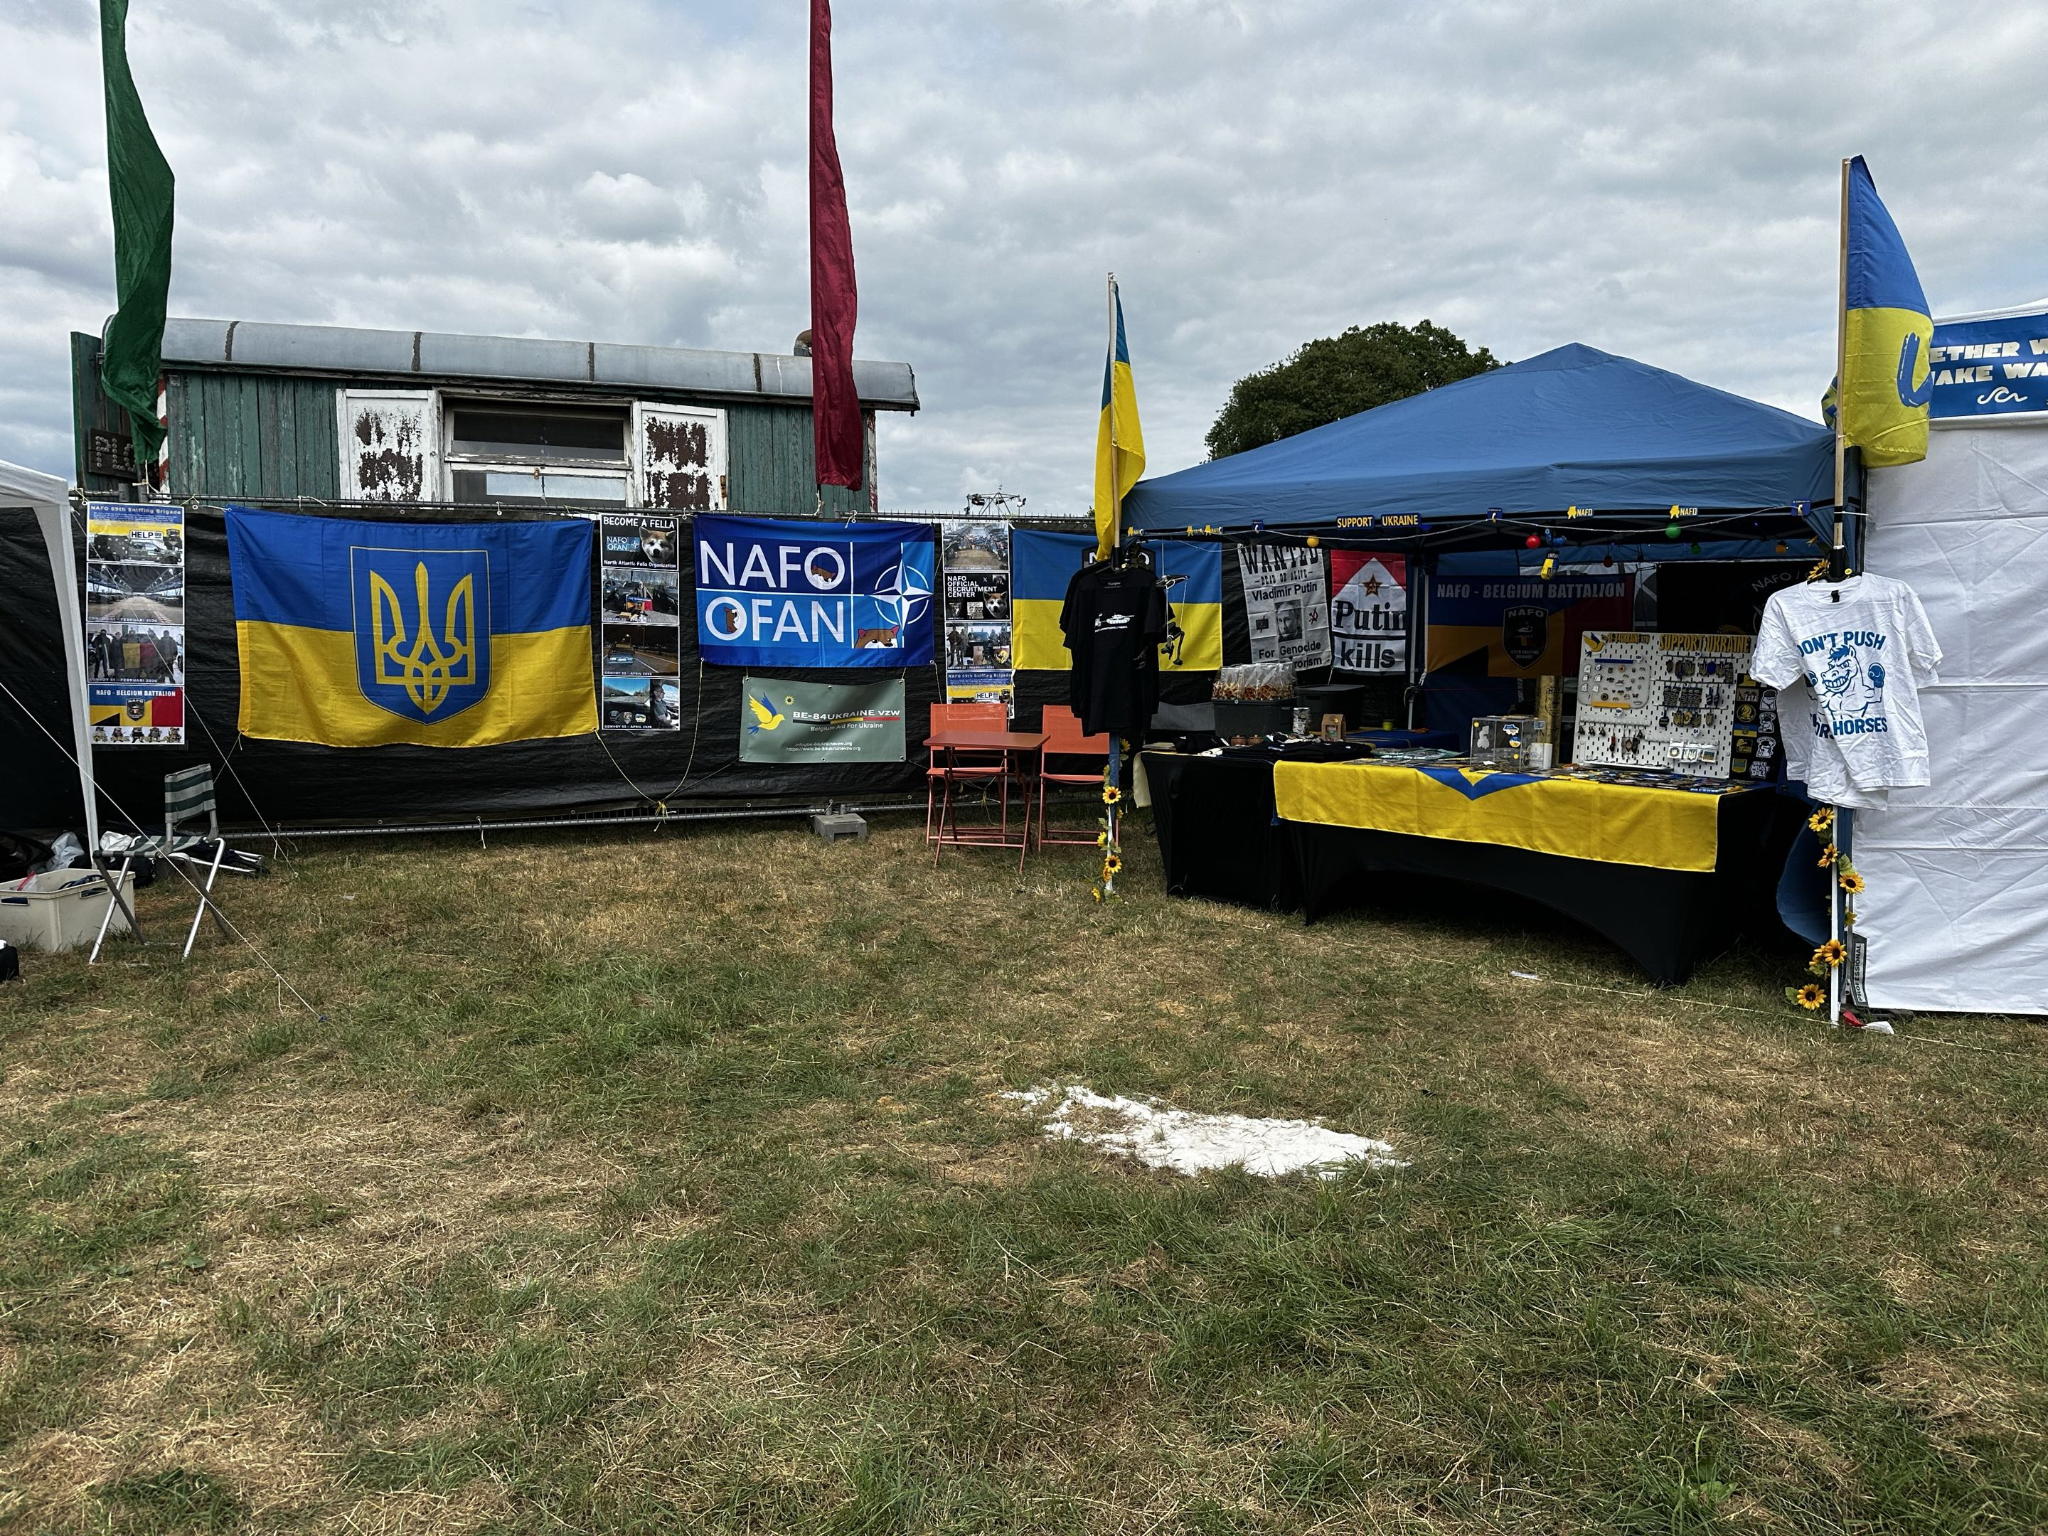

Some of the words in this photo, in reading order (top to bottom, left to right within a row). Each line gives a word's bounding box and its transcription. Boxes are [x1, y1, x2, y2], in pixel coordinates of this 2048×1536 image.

[1930, 365, 1994, 386] AKE
[1336, 516, 1373, 528] SUPPORT
[1381, 514, 1419, 527] UKRAINE
[1576, 508, 1593, 517] NAFO
[1680, 507, 1698, 516] NAFO
[603, 516, 639, 527] BECOME
[641, 519, 647, 527] A
[649, 519, 675, 529] FELLA
[131, 531, 154, 539] HELP
[606, 536, 628, 544] NAFO
[700, 540, 846, 591] NAFO
[1240, 544, 1319, 575] WANTED
[1252, 586, 1292, 601] Vladimir
[1294, 582, 1318, 595] Putin
[1437, 584, 1471, 598] NAFO
[1482, 583, 1544, 599] BELGIUM
[1548, 582, 1625, 598] BATTALION
[1751, 572, 1792, 592] NAFO
[705, 596, 845, 644] OFAN
[1333, 600, 1406, 631] Putin
[1508, 608, 1544, 618] NAFO
[1258, 648, 1275, 659] For
[1280, 640, 1322, 656] Genocide
[1659, 634, 1702, 652] SUPPORT
[1705, 635, 1751, 653] UKRAINE
[1843, 631, 1886, 650] PUSH
[1340, 641, 1396, 669] kills
[792, 709, 875, 720] BE-84UKRAINE
[810, 725, 835, 733] Belgium
[1833, 717, 1888, 736] HORSES
[1854, 944, 1863, 1002] PROFESSIONAL
